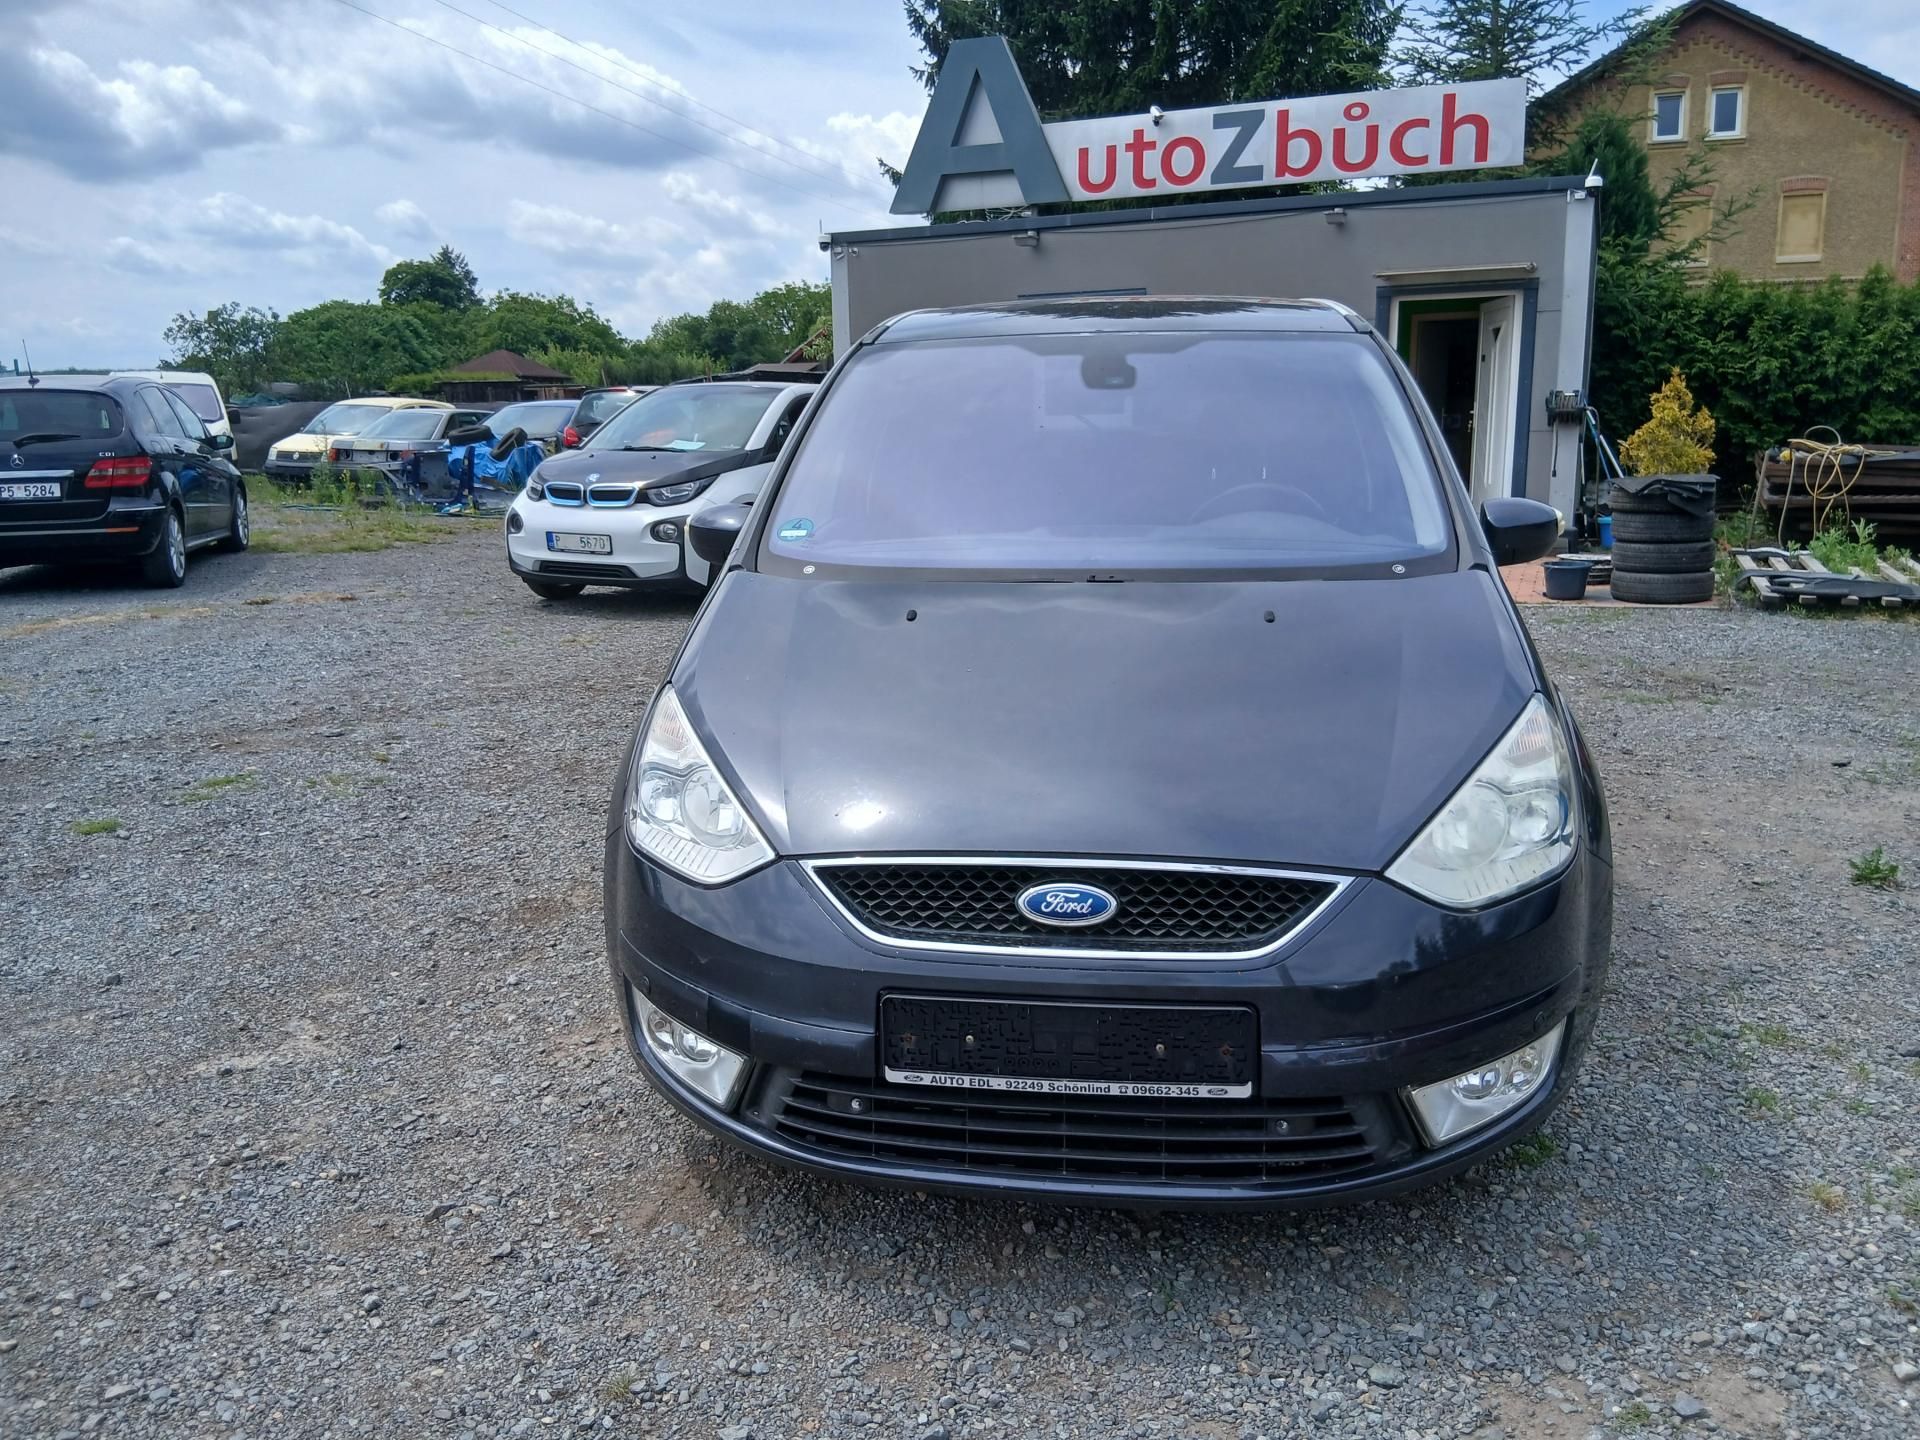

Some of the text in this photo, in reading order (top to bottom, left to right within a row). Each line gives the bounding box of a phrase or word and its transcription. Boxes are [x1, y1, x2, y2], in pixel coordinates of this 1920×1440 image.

[890, 36, 1490, 215] AutoZbůch
[24, 485, 55, 497] 5284
[1041, 891, 1093, 914] Ford
[930, 1075, 965, 1086] AUTO
[969, 1077, 994, 1088] EDL
[1005, 1079, 1044, 1091] 92249
[1047, 1082, 1111, 1094] Schönlind
[1132, 1085, 1200, 1096] 09662-345
